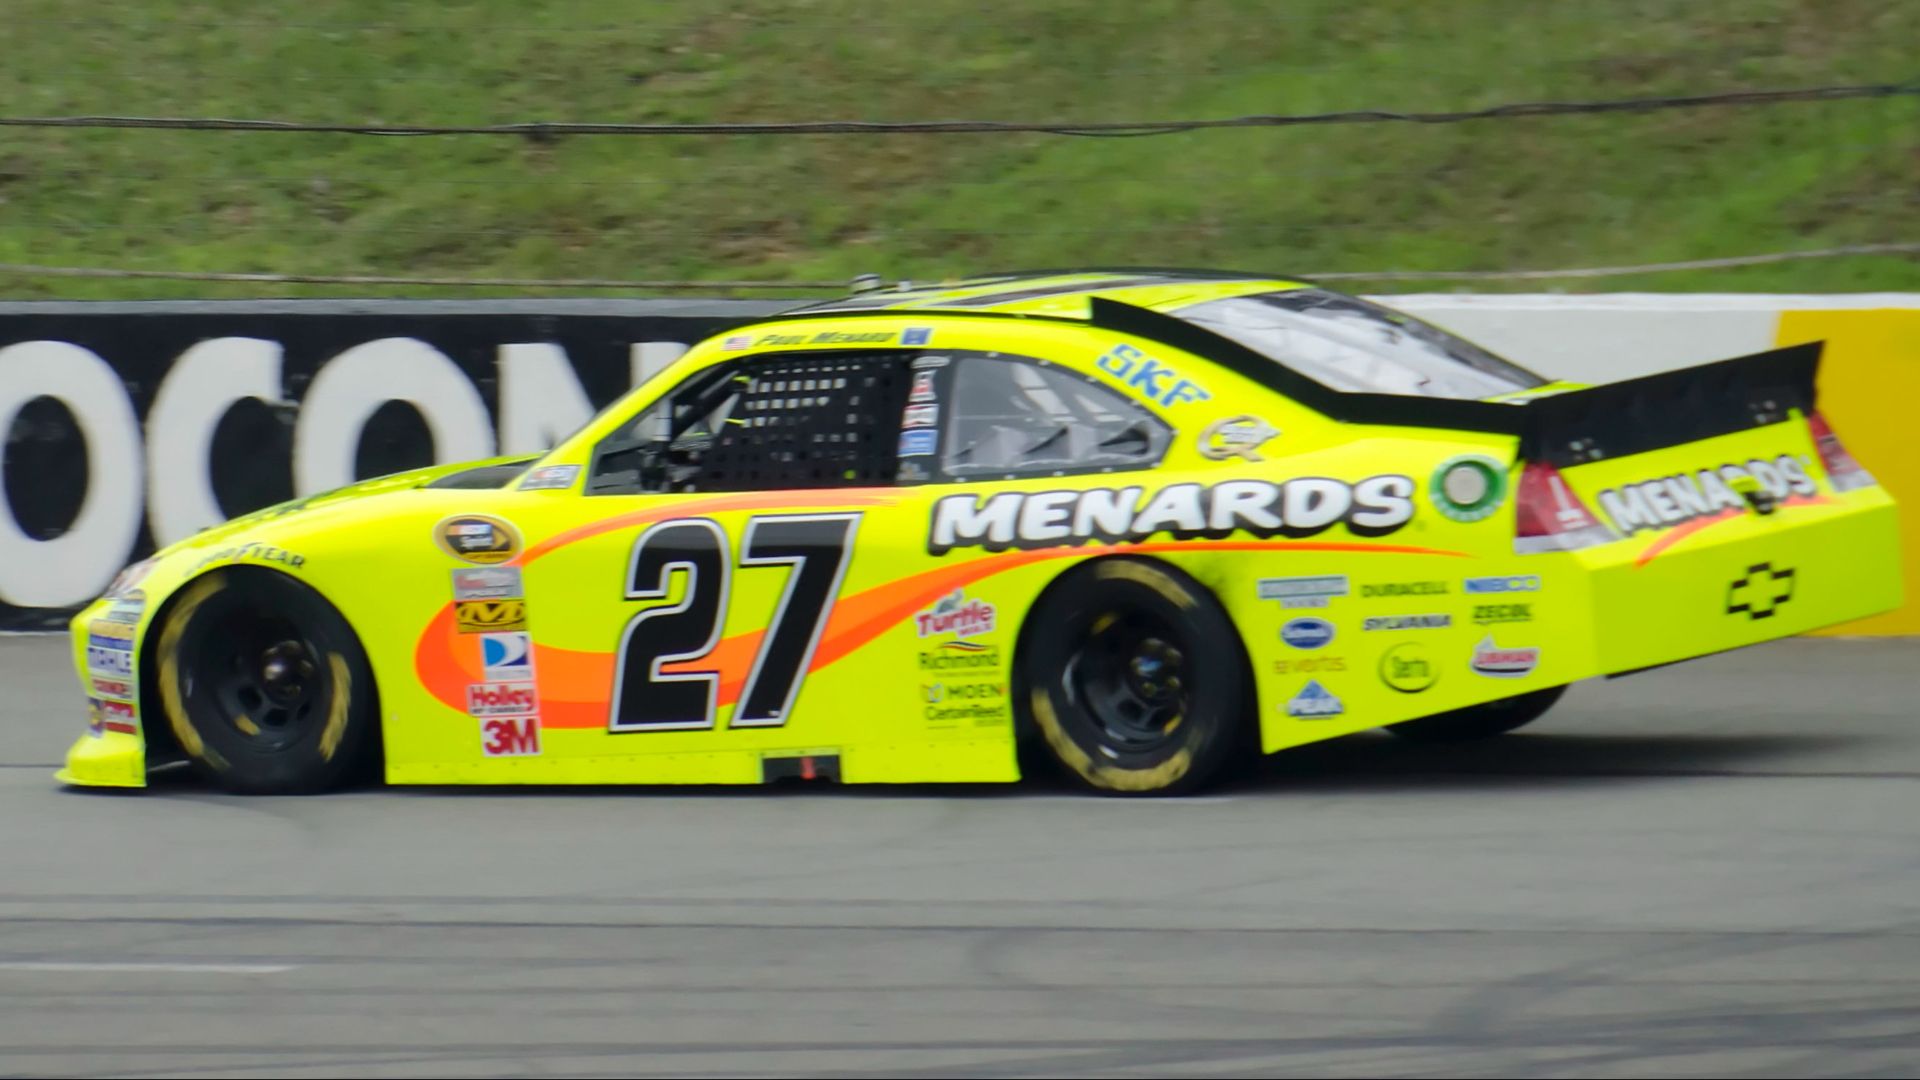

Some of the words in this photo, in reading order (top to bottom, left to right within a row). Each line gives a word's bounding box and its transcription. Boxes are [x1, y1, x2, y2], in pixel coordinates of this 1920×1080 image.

[1096, 344, 1212, 408] SKF
[928, 474, 1416, 556] MENARDS
[1361, 581, 1449, 597] DURACELL
[608, 511, 864, 734] 27
[917, 601, 993, 636] Turtle
[469, 684, 535, 712] Holley
[484, 718, 539, 755] 3M
